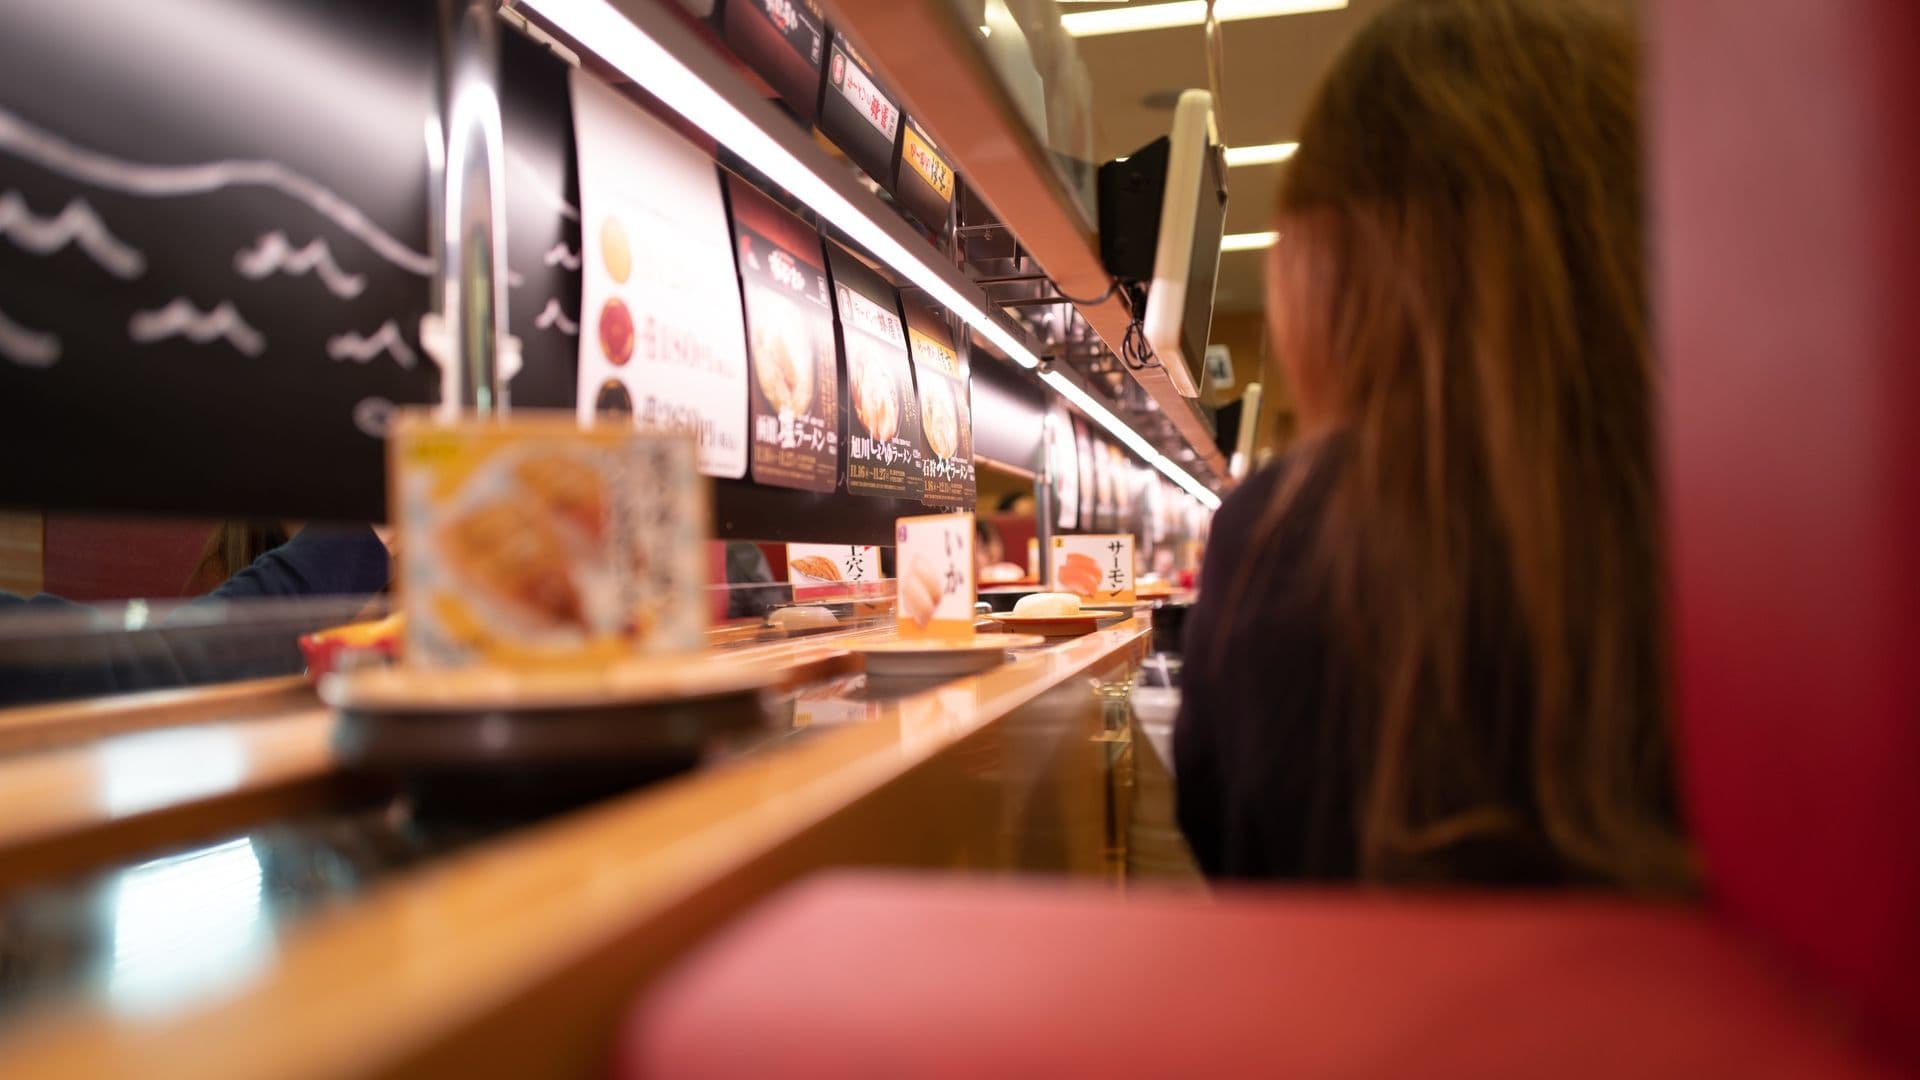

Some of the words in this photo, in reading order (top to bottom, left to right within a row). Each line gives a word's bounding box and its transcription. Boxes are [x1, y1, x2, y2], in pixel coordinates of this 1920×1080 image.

[850, 432, 912, 466] 旭川しょうゆラーメン
[944, 529, 964, 595] いか
[1107, 541, 1124, 597] サーモン
